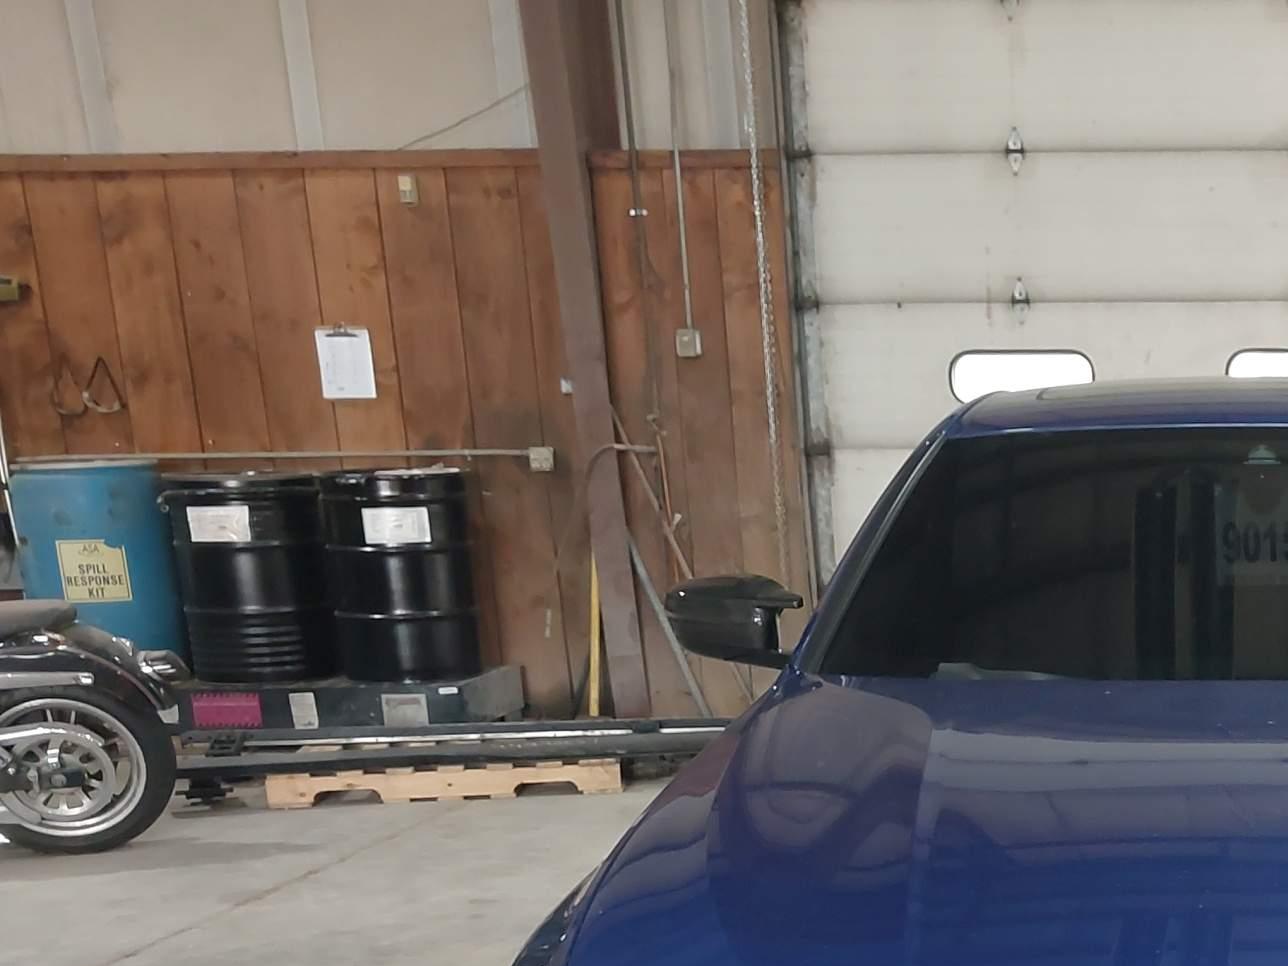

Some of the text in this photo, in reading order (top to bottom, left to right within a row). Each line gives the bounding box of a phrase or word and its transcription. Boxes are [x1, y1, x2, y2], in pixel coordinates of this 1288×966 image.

[78, 563, 109, 575] SPILL
[66, 574, 125, 587] RESPONSE
[87, 587, 105, 599] KIT
